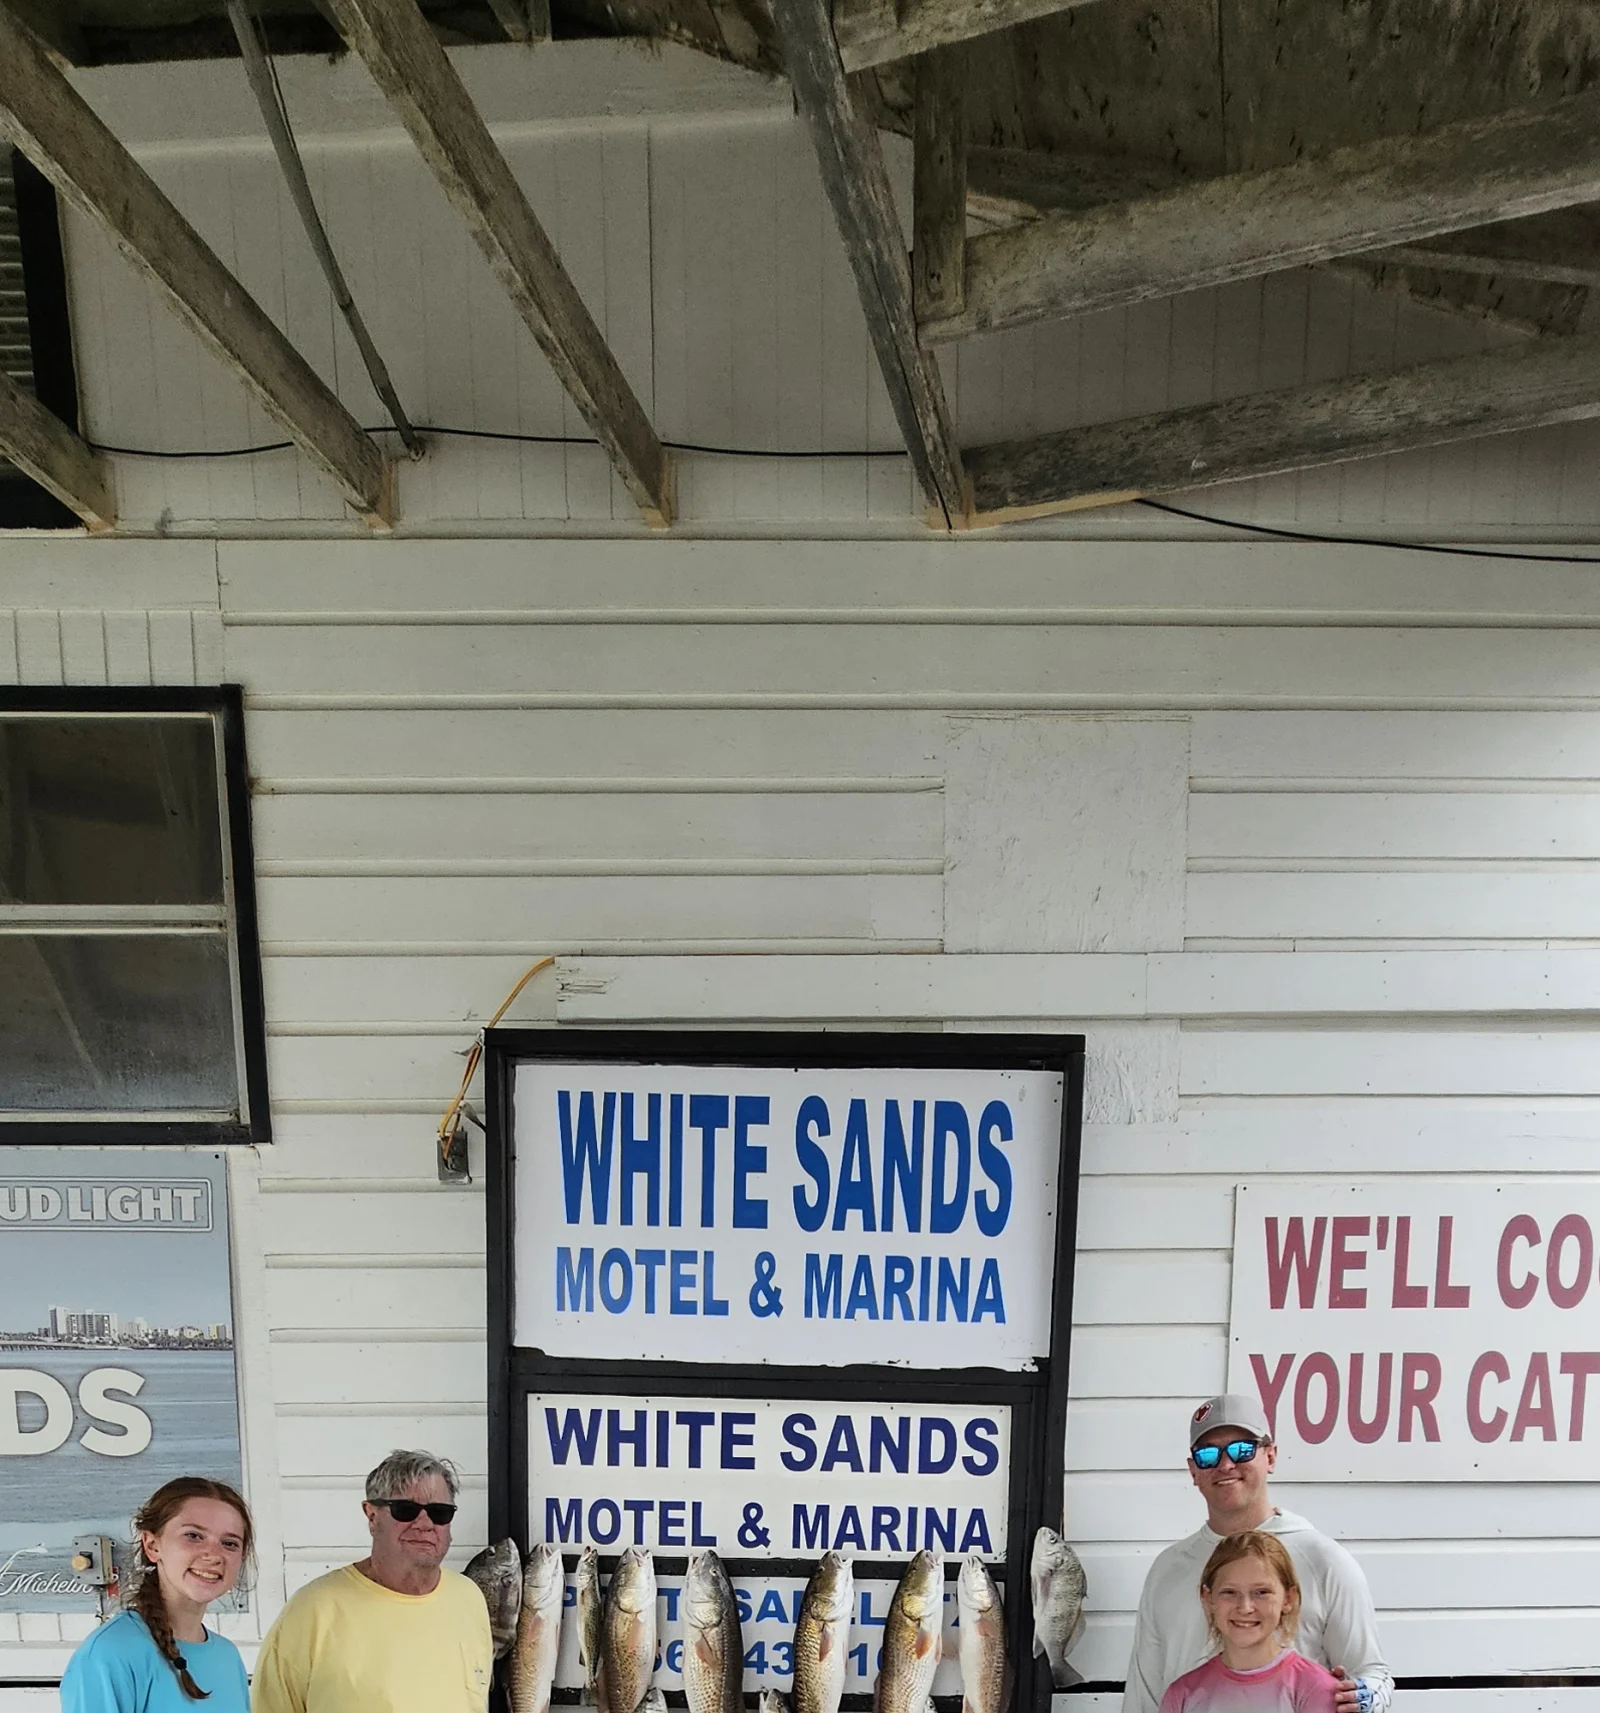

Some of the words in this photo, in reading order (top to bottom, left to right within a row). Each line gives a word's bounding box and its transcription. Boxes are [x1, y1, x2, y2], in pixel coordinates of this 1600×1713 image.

[556, 1089, 770, 1229] WHITE
[792, 1095, 1014, 1238] SANDS
[67, 1186, 202, 1222] LIGHT
[555, 1246, 730, 1317] MOTEL
[749, 1250, 784, 1319] &
[803, 1252, 1007, 1325] MARINA
[1264, 1215, 1472, 1310] WE'LL
[1496, 1213, 1600, 1310] CO
[1248, 1350, 1443, 1445] YOUR
[545, 1406, 757, 1471] WHITE
[779, 1412, 1000, 1477] SANDS
[545, 1496, 718, 1548] MOTEL
[736, 1501, 771, 1550] &
[791, 1502, 993, 1555] MARINA
